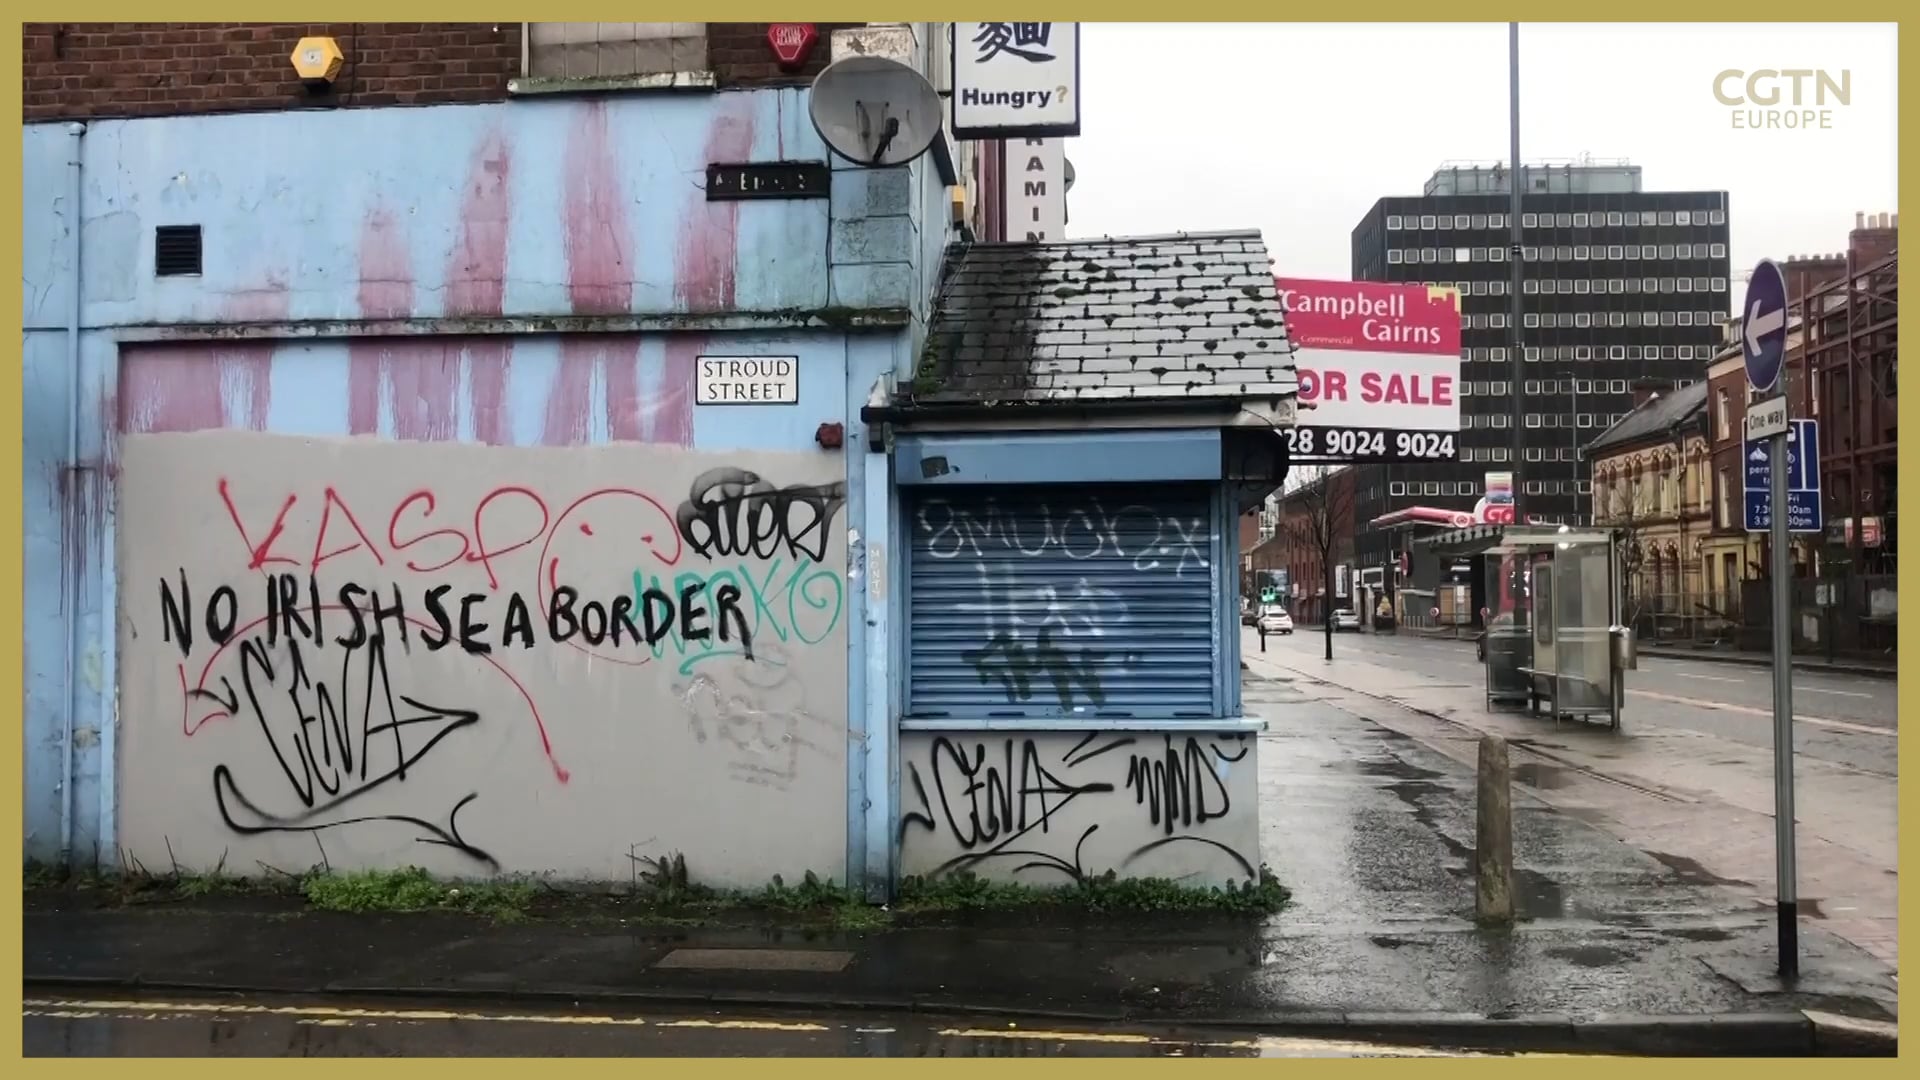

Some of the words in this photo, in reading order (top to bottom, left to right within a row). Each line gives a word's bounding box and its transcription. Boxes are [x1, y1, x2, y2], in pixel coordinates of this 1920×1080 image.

[1281, 289, 1405, 320] Campbell
[1300, 335, 1354, 345] Commercial
[1362, 318, 1441, 344] Cairns
[703, 360, 790, 378] STROUD
[708, 382, 786, 400] STREET
[1297, 369, 1348, 401] OR
[1360, 372, 1453, 406] SALE
[1750, 415, 1765, 430] One
[1767, 408, 1785, 426] way
[1283, 429, 1314, 453] 28
[1325, 430, 1386, 455] 9024
[1396, 432, 1455, 458] 9024
[161, 568, 238, 657] NO
[266, 573, 410, 655] IRISH
[420, 583, 536, 655] SEA
[548, 582, 755, 662] BORDER
